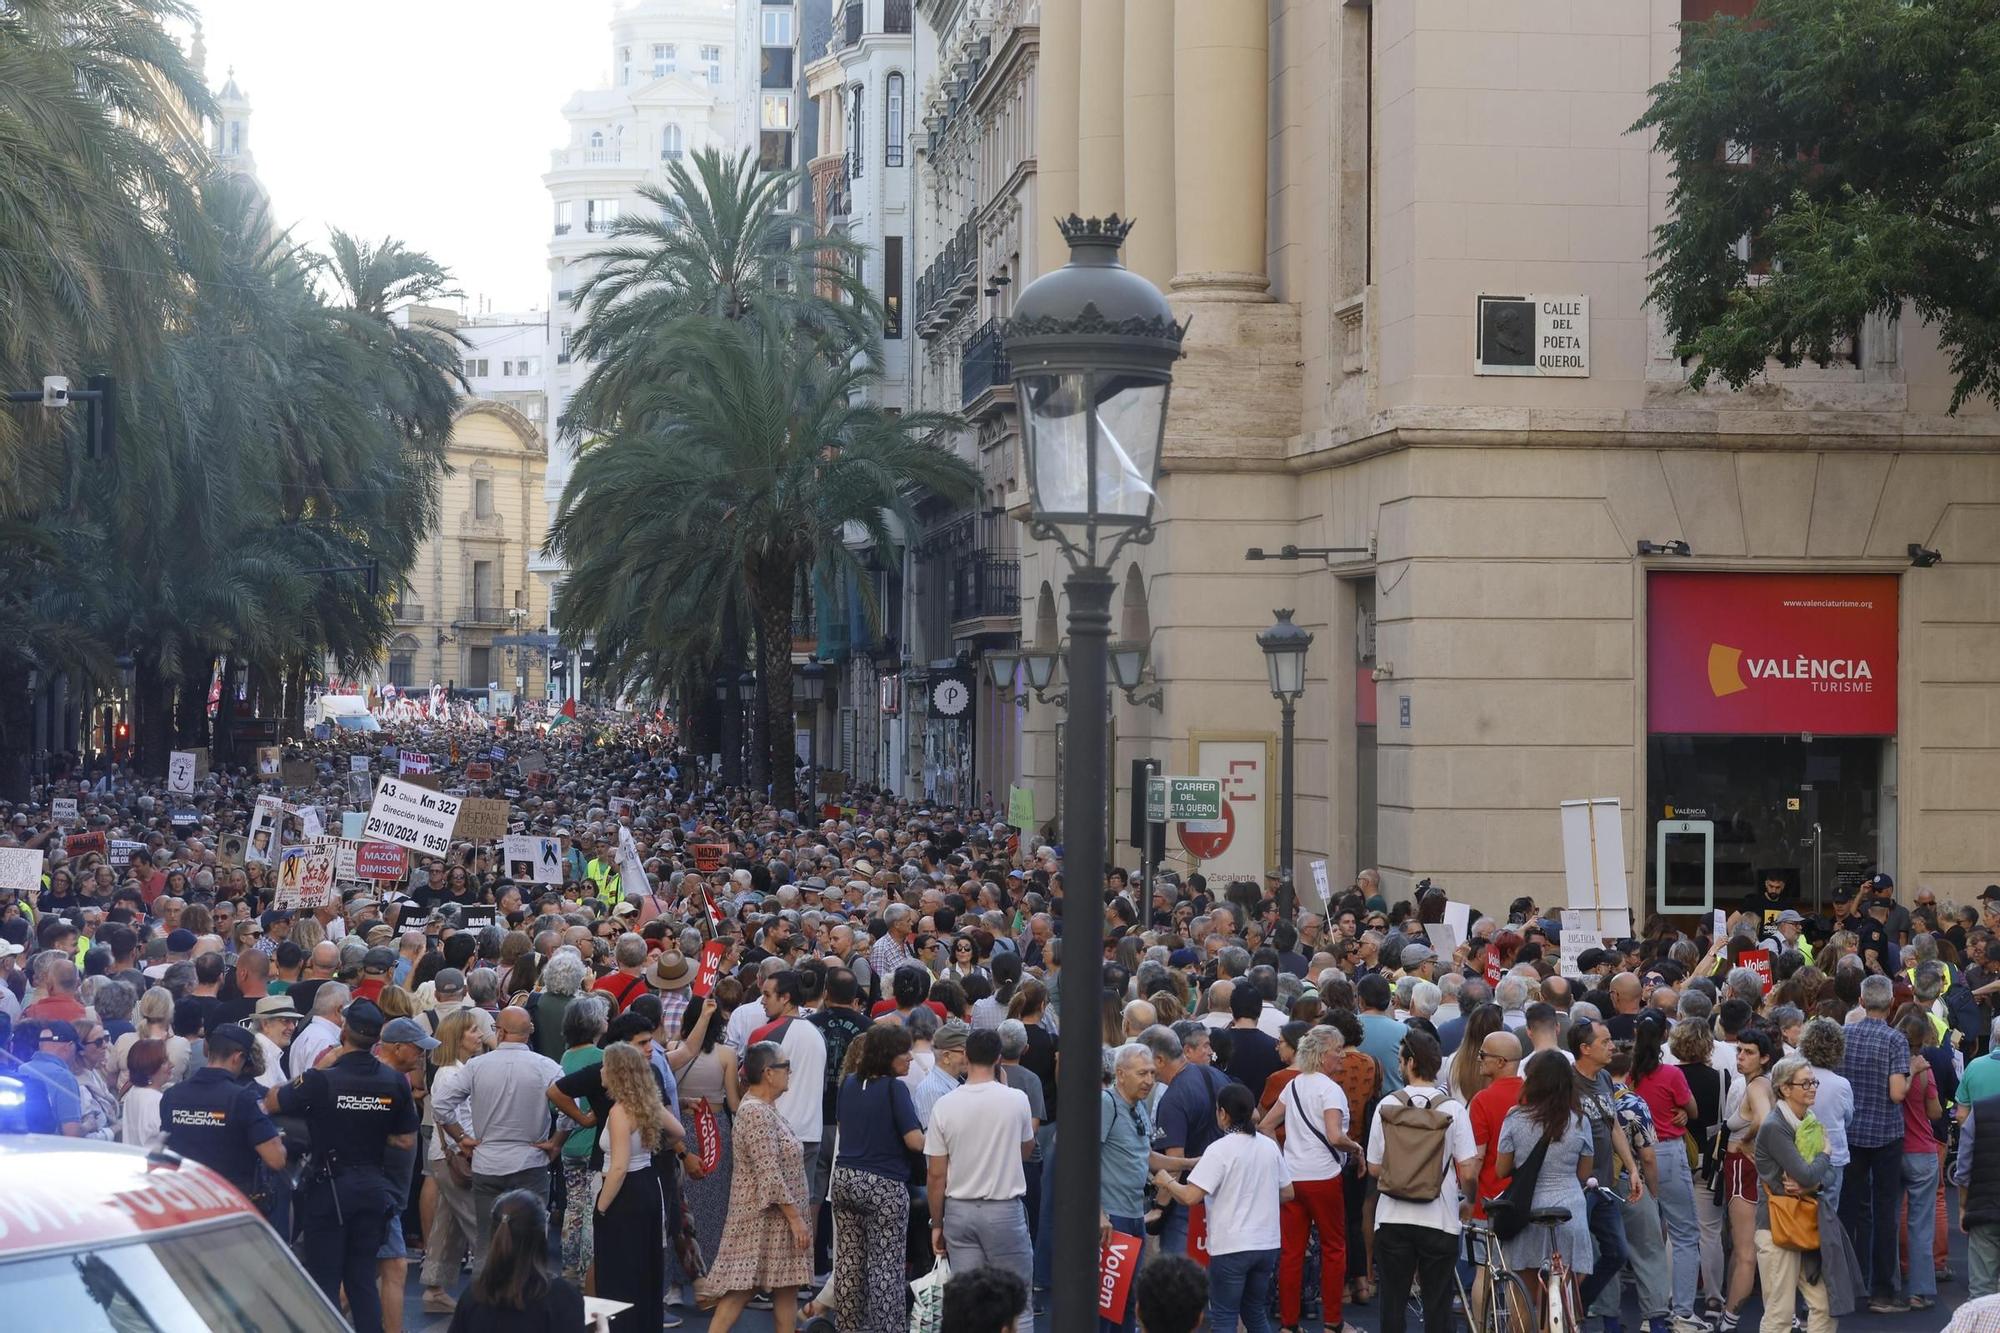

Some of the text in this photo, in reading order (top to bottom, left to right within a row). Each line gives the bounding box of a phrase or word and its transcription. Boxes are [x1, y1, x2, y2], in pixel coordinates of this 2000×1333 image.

[1543, 302, 1581, 315] CALLE
[1552, 319, 1573, 330] DEL
[1543, 336, 1581, 349] POETA
[1539, 355, 1585, 368] QUEROL
[1783, 600, 1873, 609] www.valenciaturisme.org
[1747, 654, 1873, 679] VALÈNCIA
[1811, 682, 1873, 692] TURISME
[1175, 782, 1216, 791] CARRER
[1180, 793, 1196, 801] DEL
[420, 794, 436, 809] Km
[437, 799, 457, 815] 322
[1170, 803, 1217, 812] ETA QUEROL
[383, 804, 444, 828] Dirección Valencia
[1674, 807, 1707, 815] VALÈNCIA
[367, 817, 448, 852] 29/10/2024 19:50
[364, 851, 401, 862] MAZÓN
[337, 1095, 380, 1104] POLICIA
[337, 1103, 390, 1111] NACIONAL
[172, 1110, 214, 1119] POLICIA
[172, 1117, 226, 1127] NACIONAL
[1099, 1244, 1129, 1309] Volem
